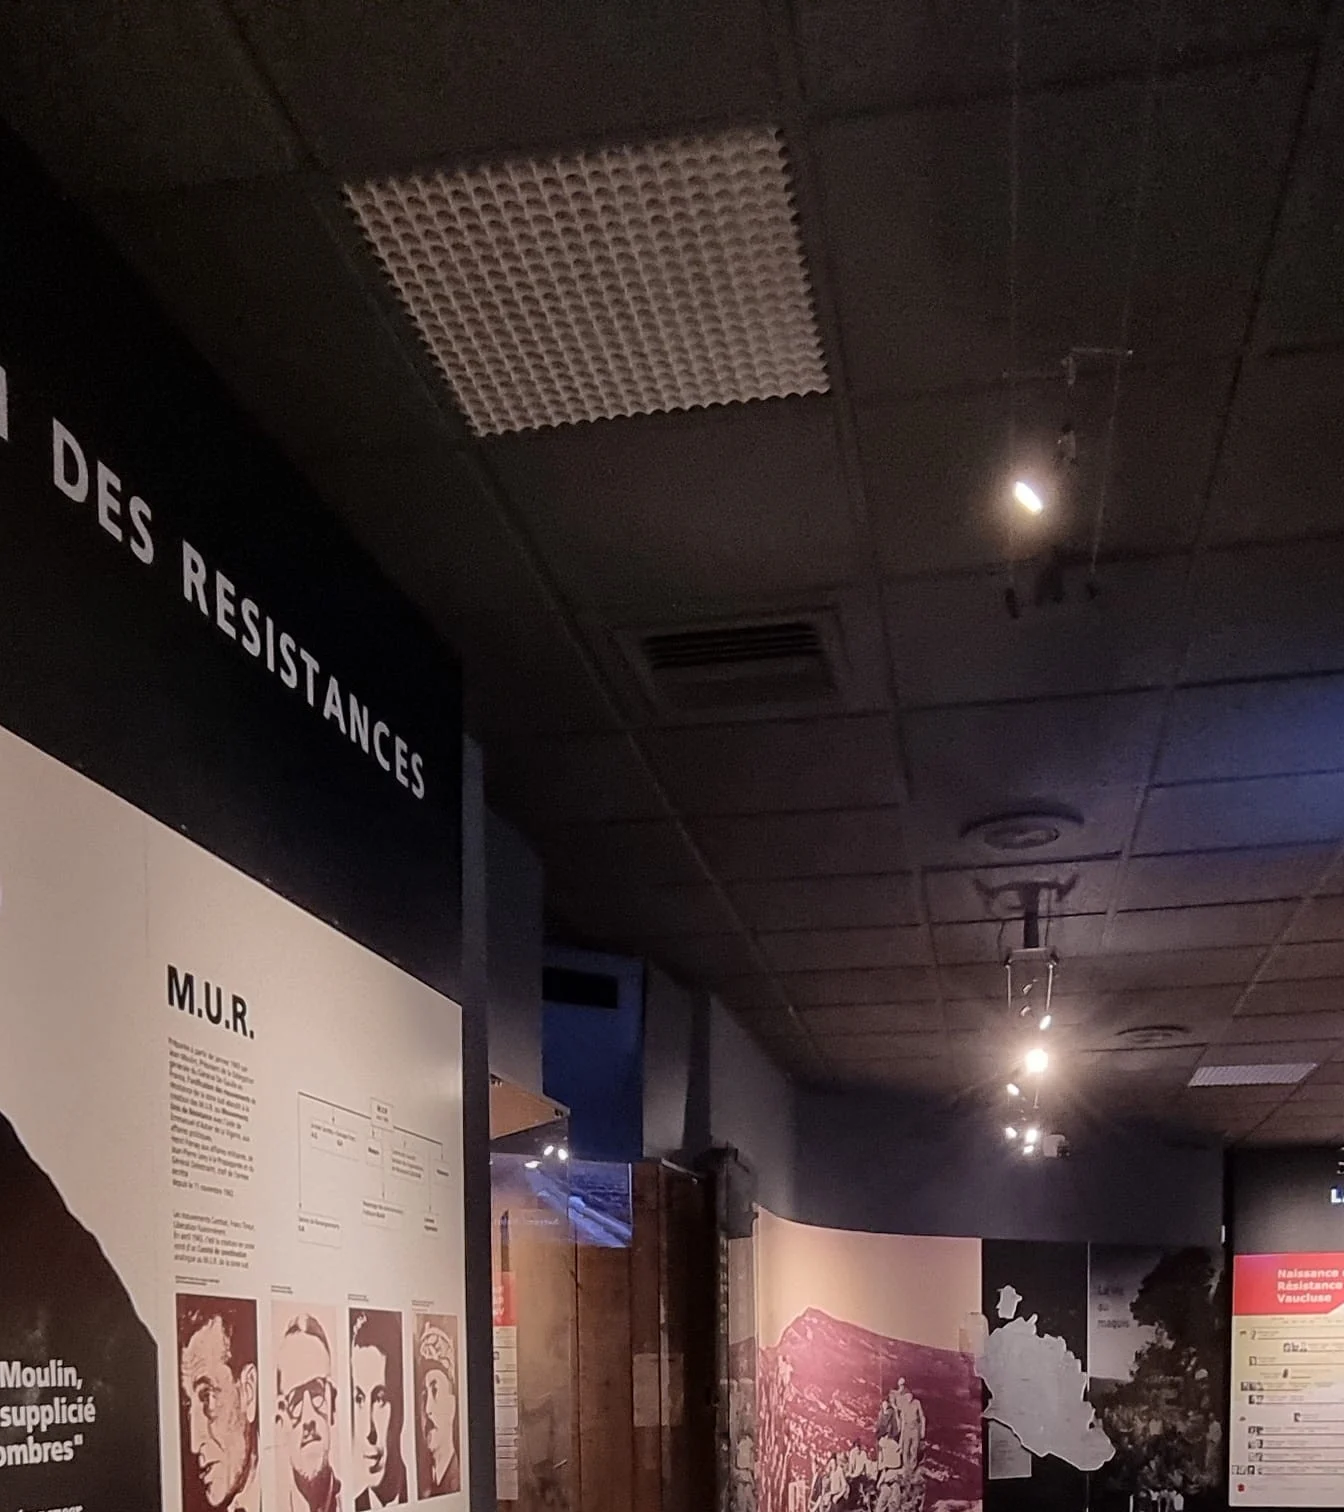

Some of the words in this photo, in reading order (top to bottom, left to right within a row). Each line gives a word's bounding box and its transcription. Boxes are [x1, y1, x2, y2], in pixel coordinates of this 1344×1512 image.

[53, 417, 154, 564] DES
[182, 538, 426, 800] RESISTANCES
[166, 964, 255, 1040] M.U.R.
[1277, 1268, 1339, 1279] Naissance
[1277, 1280, 1343, 1291] Résistance
[1277, 1293, 1332, 1303] Vaucluse
[0, 1359, 83, 1390] Moulin,
[0, 1396, 96, 1433] supplicié
